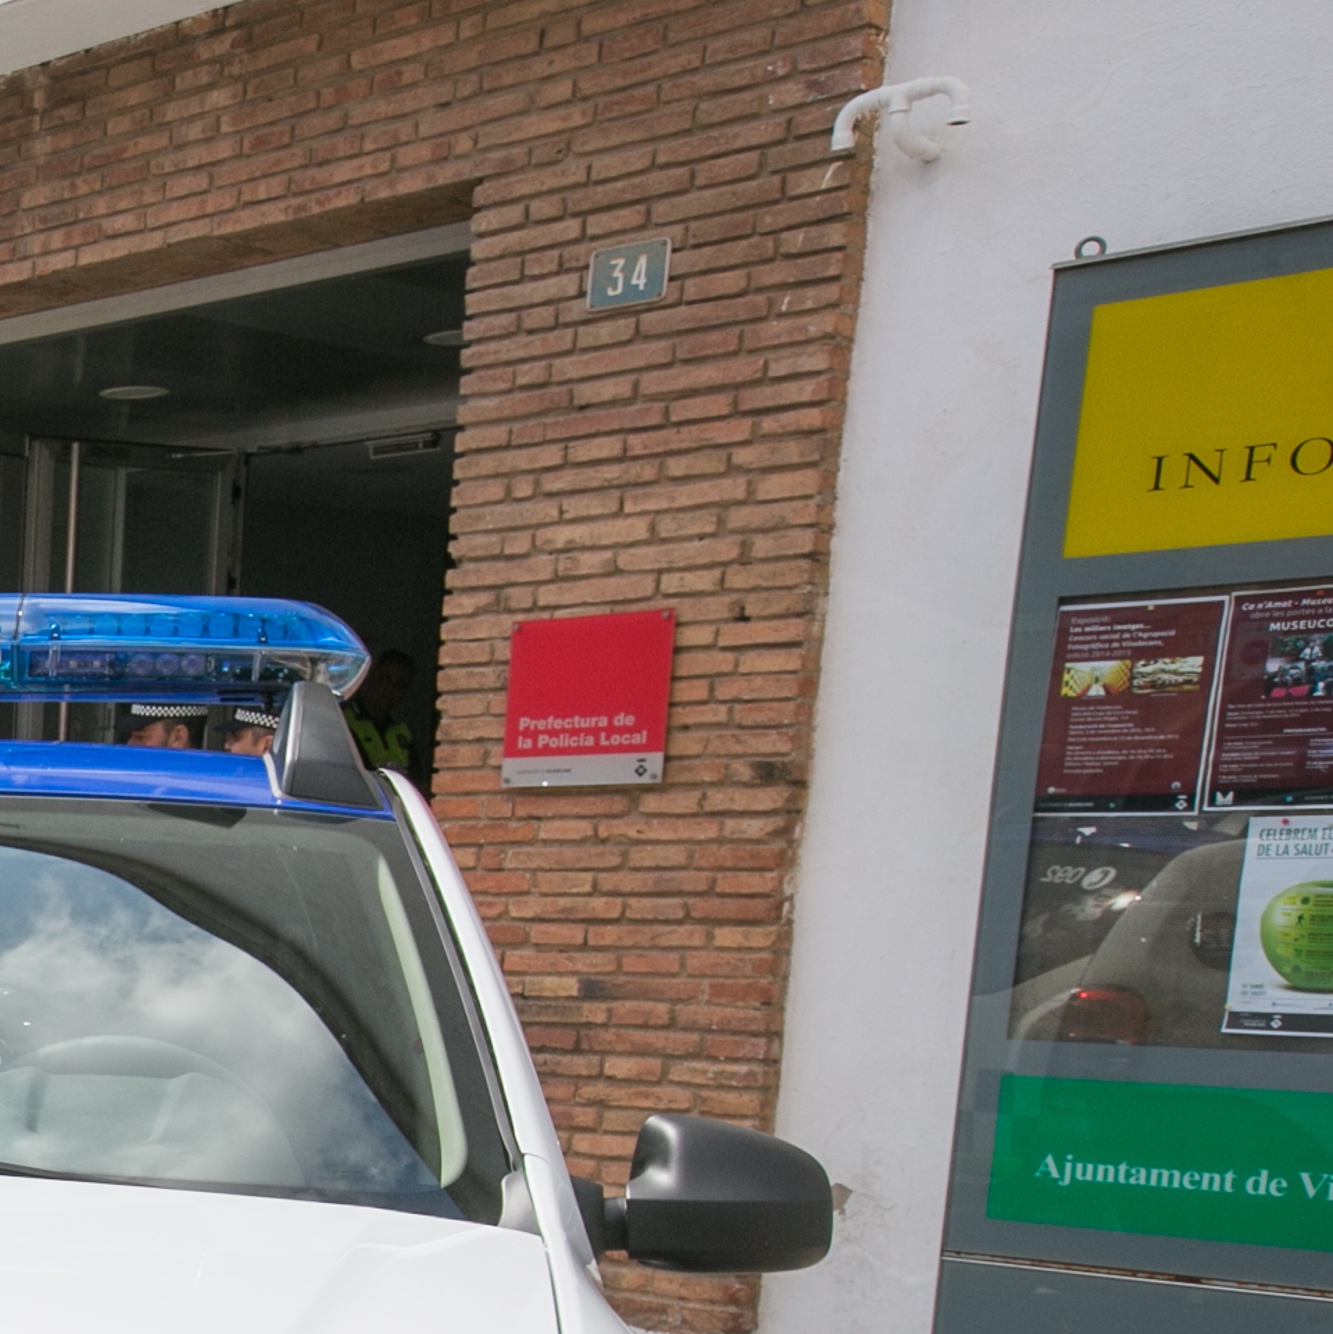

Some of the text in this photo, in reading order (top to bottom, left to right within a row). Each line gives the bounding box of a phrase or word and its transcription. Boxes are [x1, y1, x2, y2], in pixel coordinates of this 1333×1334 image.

[607, 252, 647, 296] 34
[1146, 437, 1333, 492] INFO
[519, 712, 636, 731] Prefectura de
[517, 730, 648, 749] la Policia Local
[1259, 828, 1318, 841] CELEBREM
[1257, 843, 1330, 856] DE LA SALUT
[1034, 1153, 1239, 1193] Ajuntament
[1245, 1169, 1288, 1197] de
